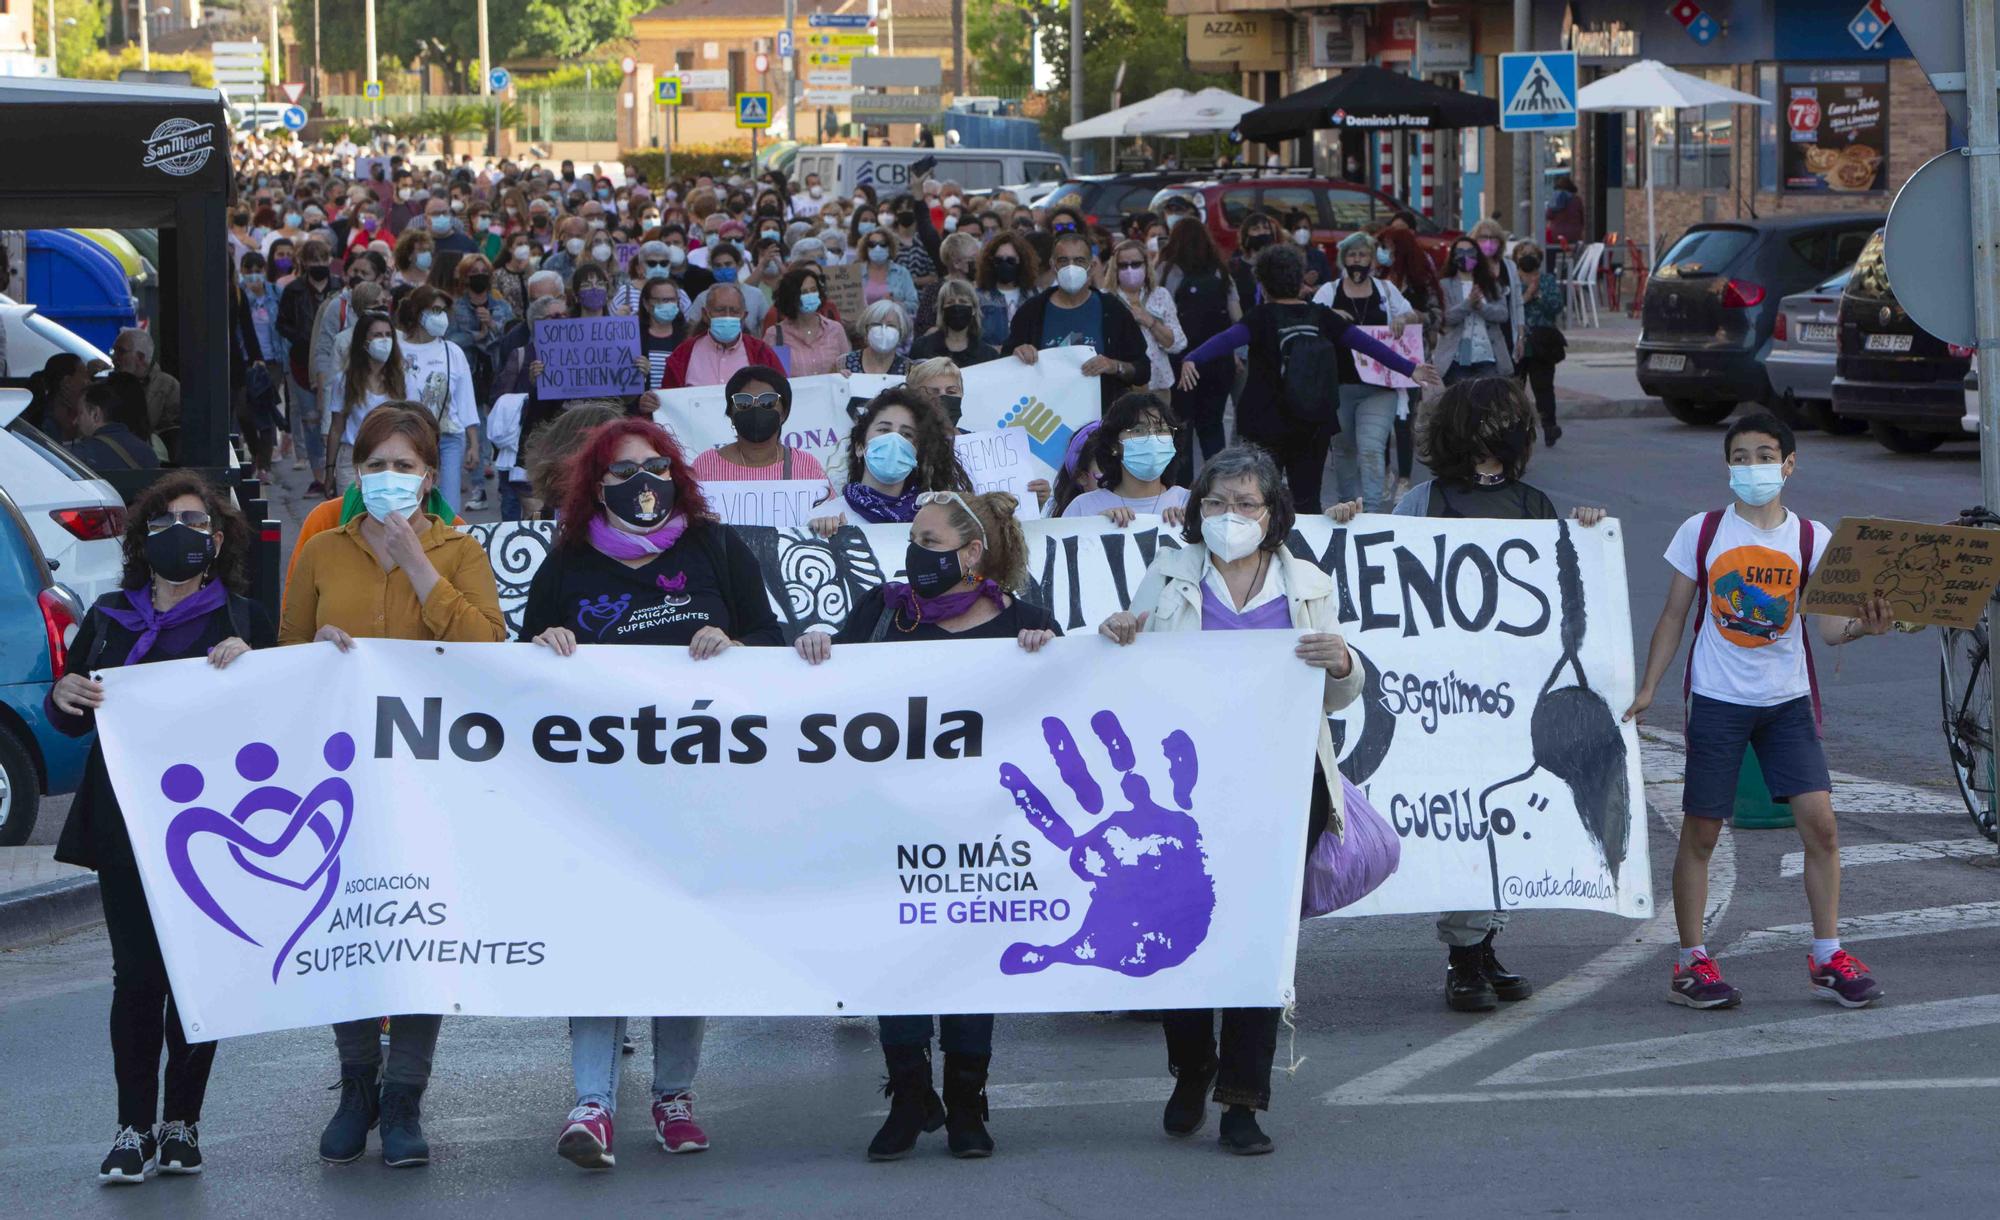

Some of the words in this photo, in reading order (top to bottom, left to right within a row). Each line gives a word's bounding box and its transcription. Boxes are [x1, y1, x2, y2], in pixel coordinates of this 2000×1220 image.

[1204, 21, 1257, 34] AZZATI
[1346, 114, 1397, 126] Domino's
[1399, 114, 1430, 126] Pizza
[143, 143, 171, 163] San
[168, 129, 212, 152] Miguel
[539, 323, 584, 345] SOMOS
[592, 322, 603, 341] EL
[605, 320, 636, 341] GRITO
[541, 348, 556, 367] DE
[560, 347, 580, 367] LAS
[584, 346, 613, 366] QUE
[617, 345, 633, 366] YA
[542, 369, 564, 388] NO
[566, 366, 608, 387] TIENEN
[609, 366, 642, 391] VOZ
[1856, 525, 1893, 541] TOCAR
[1745, 566, 1794, 585] SKATE
[1960, 565, 1974, 574] ES
[617, 612, 710, 635] SUPERVIVIENTES
[629, 607, 677, 623] AMIGAS
[1379, 669, 1515, 733] seguimos
[374, 695, 505, 763] No
[532, 699, 768, 765] estás
[797, 696, 984, 764] sola
[896, 843, 947, 870] NO
[958, 834, 1033, 869] MÁS
[345, 873, 430, 895] ASOCIACIÓN
[899, 871, 1039, 894] VIOLENCIA
[328, 900, 448, 934] AMIGAS
[899, 902, 937, 924] DE
[947, 896, 1071, 924] GÉNERO
[295, 938, 547, 976] SUPERVIVIENTES
